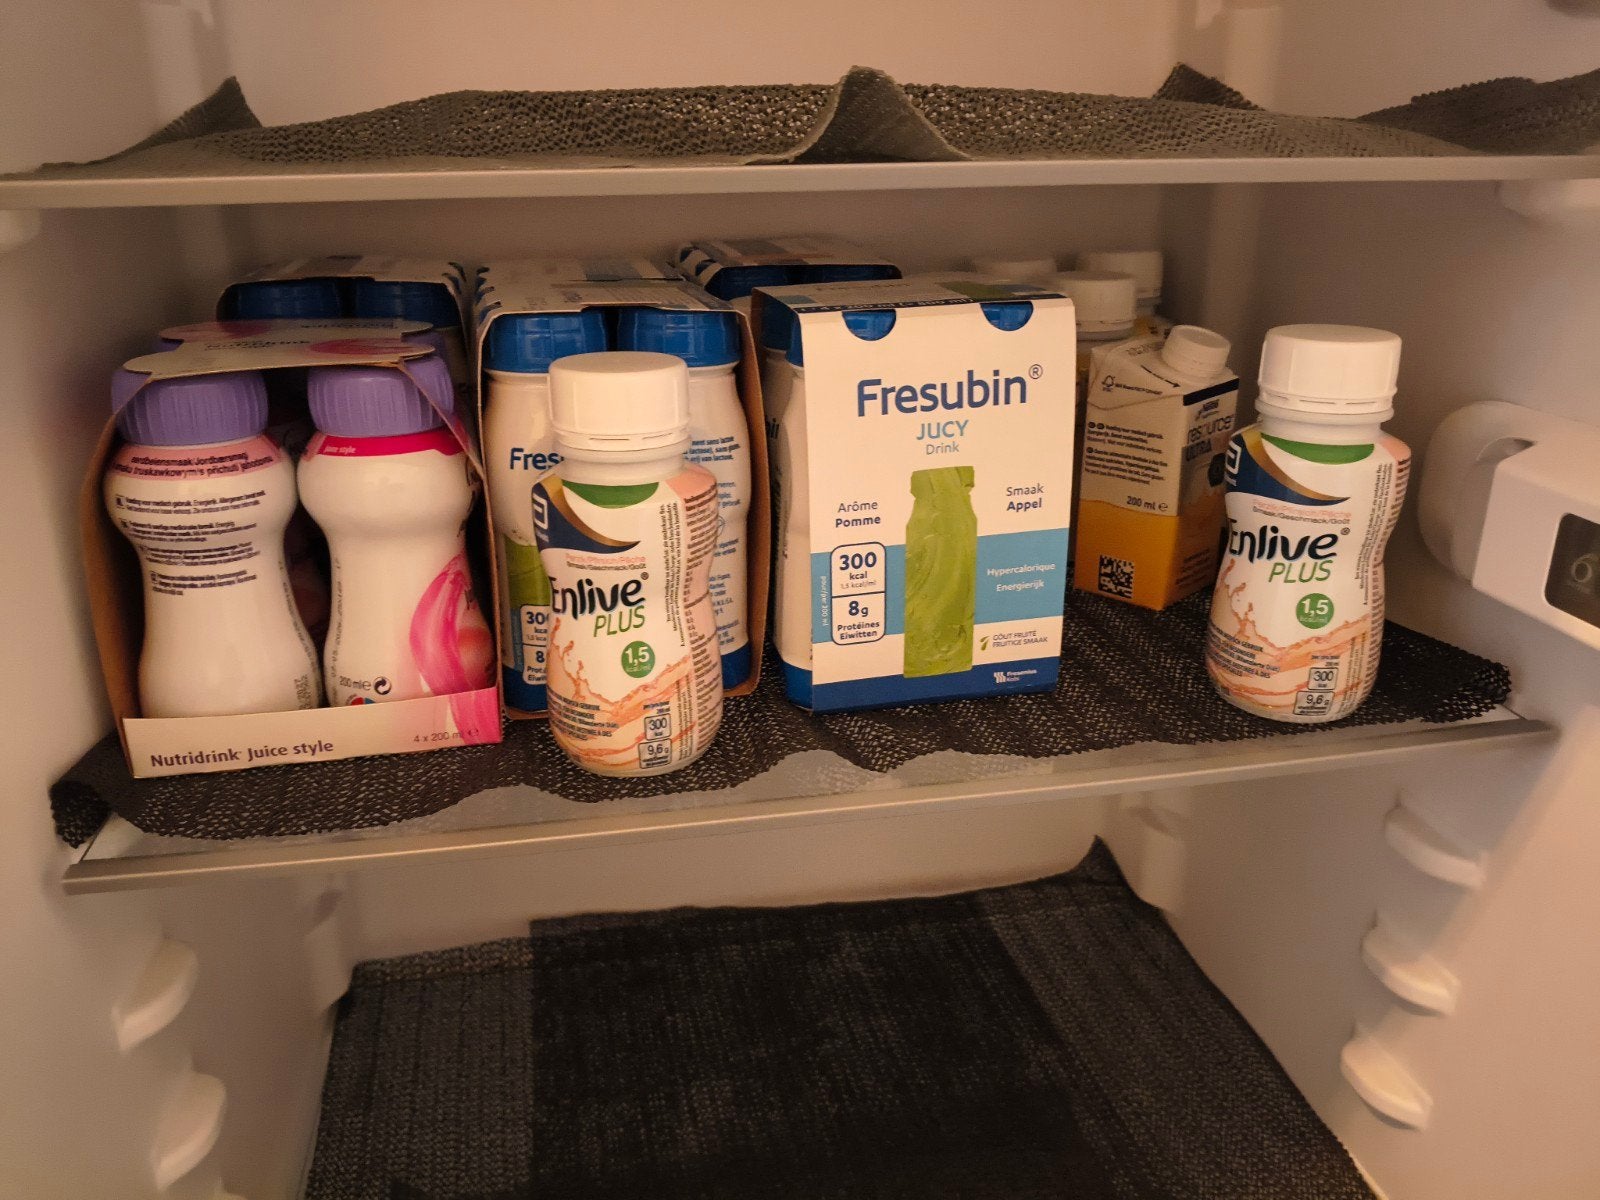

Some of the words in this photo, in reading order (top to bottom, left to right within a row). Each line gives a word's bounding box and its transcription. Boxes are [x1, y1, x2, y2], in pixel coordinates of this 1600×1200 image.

[916, 419, 970, 441] JUCY
[925, 441, 960, 455] Drink
[509, 447, 565, 471] Fres
[1006, 482, 1045, 497] Smaak
[838, 501, 878, 513] Arôme
[1006, 498, 1042, 512] Appel
[835, 517, 881, 528] Pomme
[839, 551, 877, 570] 300
[849, 571, 867, 580] kcal
[986, 563, 1057, 577] Hypercalorique
[1268, 559, 1334, 583] PLUS
[996, 579, 1045, 592] Energierijk
[1301, 598, 1329, 616] 1,5
[526, 611, 550, 625] 30
[593, 605, 646, 638] PLUS
[534, 626, 548, 634] kca
[837, 620, 880, 631] Protéines
[839, 630, 878, 640] Eiwitten
[625, 646, 650, 666] 1,5
[1313, 670, 1334, 681] 300
[648, 717, 668, 730] 300
[414, 735, 420, 743] 4
[431, 732, 450, 742] 200
[248, 745, 288, 762] Juice
[293, 740, 334, 757] style
